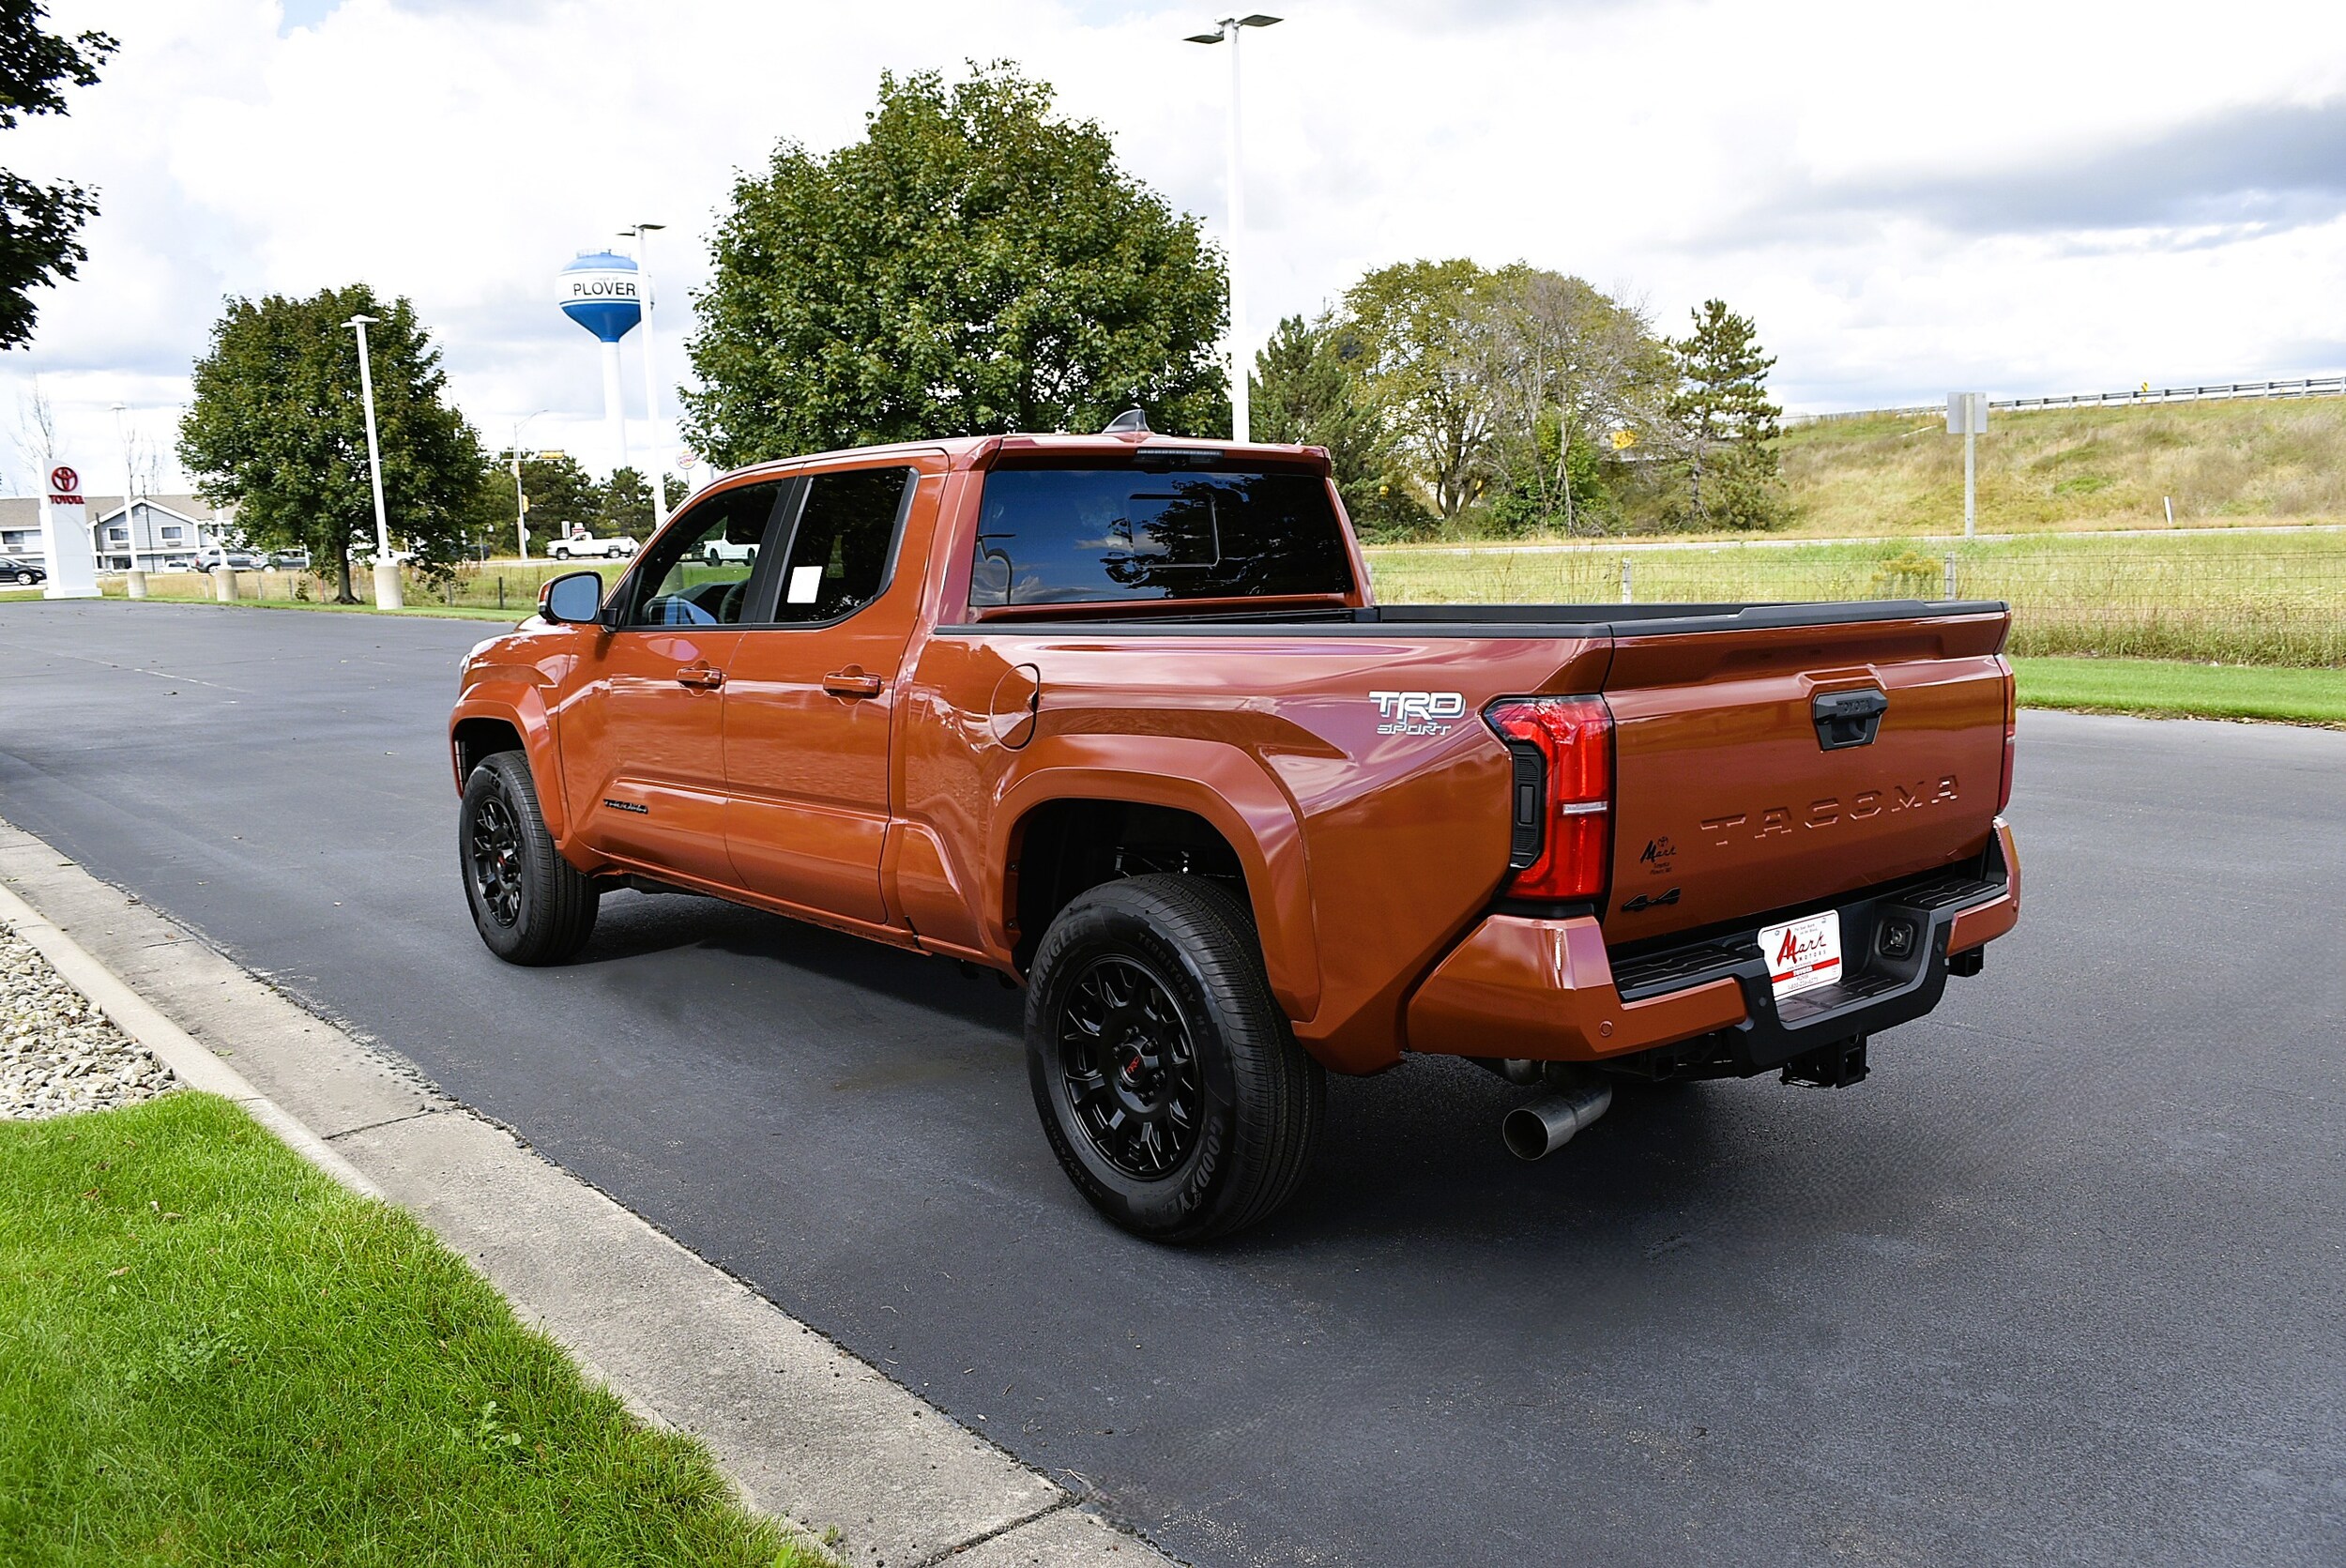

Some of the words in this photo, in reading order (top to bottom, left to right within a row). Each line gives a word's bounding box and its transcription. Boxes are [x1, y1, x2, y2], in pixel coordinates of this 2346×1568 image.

[573, 282, 636, 297] PLOVER
[48, 495, 85, 505] TOYOTA
[1369, 691, 1466, 724] TRD
[1377, 723, 1452, 736] SPORT
[1699, 775, 1958, 845] TACOMA
[1126, 1055, 1141, 1073] TRD
[1144, 1115, 1223, 1217] GOODYEA
